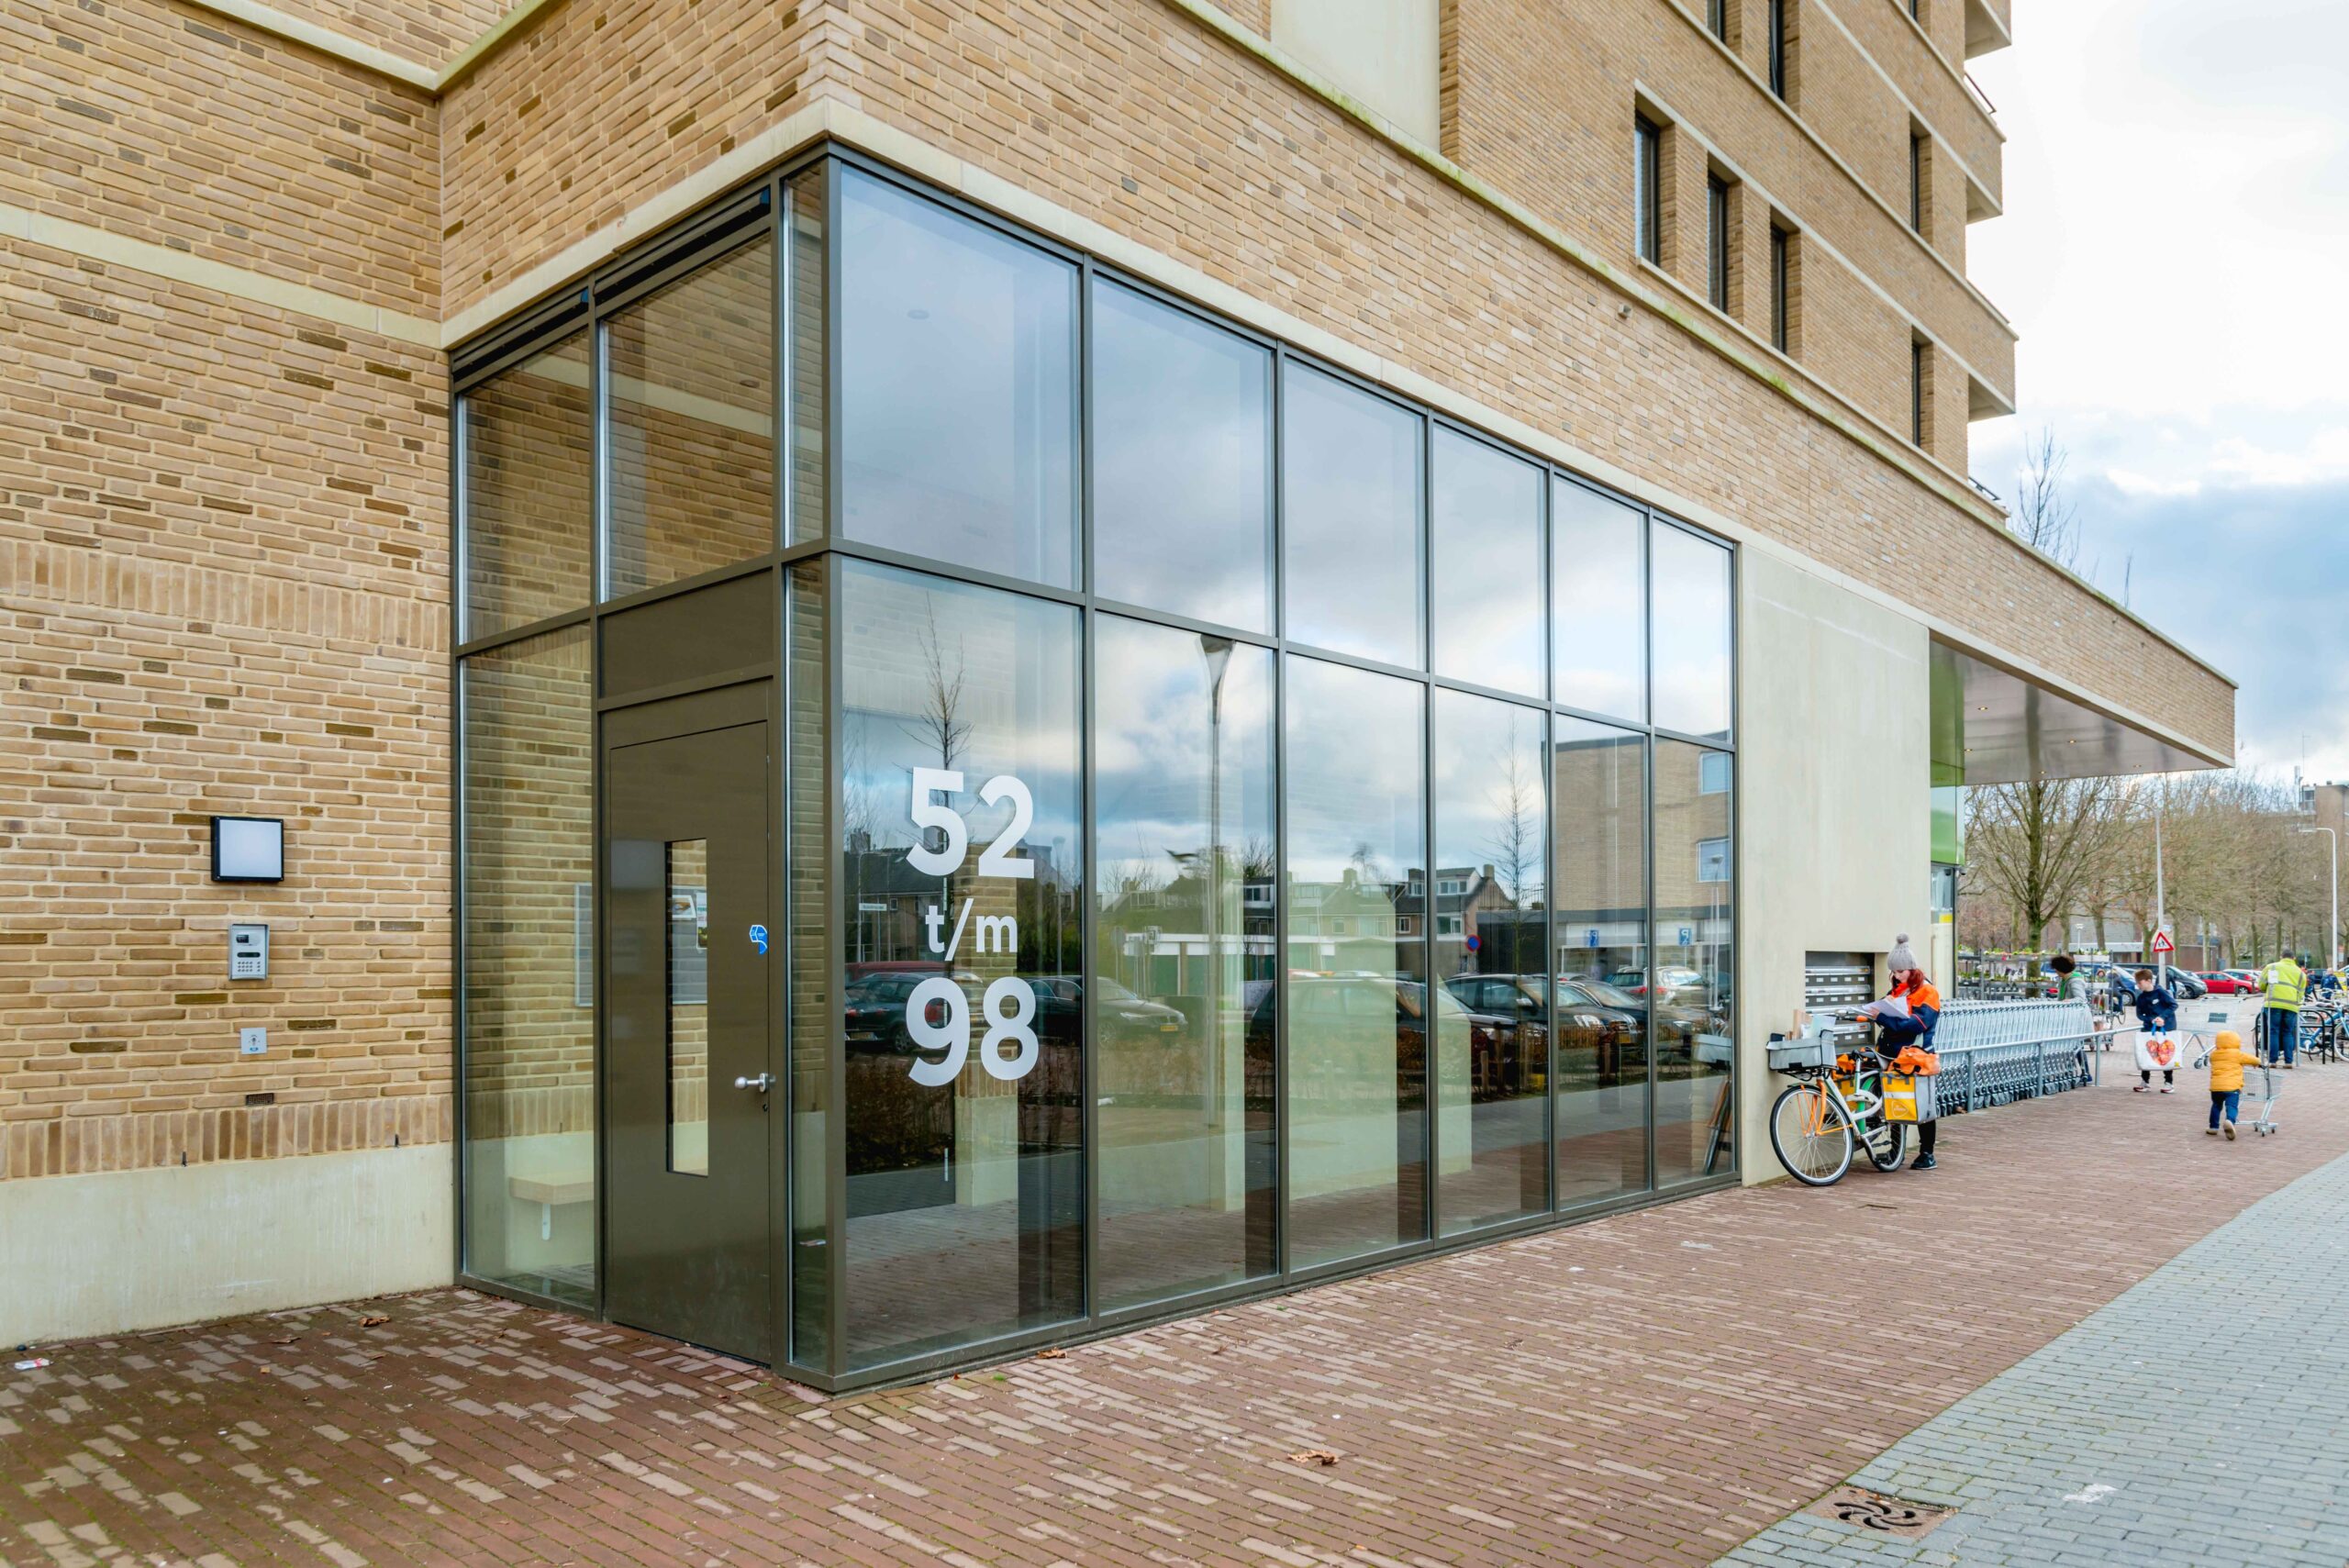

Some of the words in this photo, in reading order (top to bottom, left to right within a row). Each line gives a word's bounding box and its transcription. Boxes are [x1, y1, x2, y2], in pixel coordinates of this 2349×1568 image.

[907, 766, 1034, 878] 52
[926, 898, 1018, 962] t/m
[906, 977, 1039, 1086] 98
